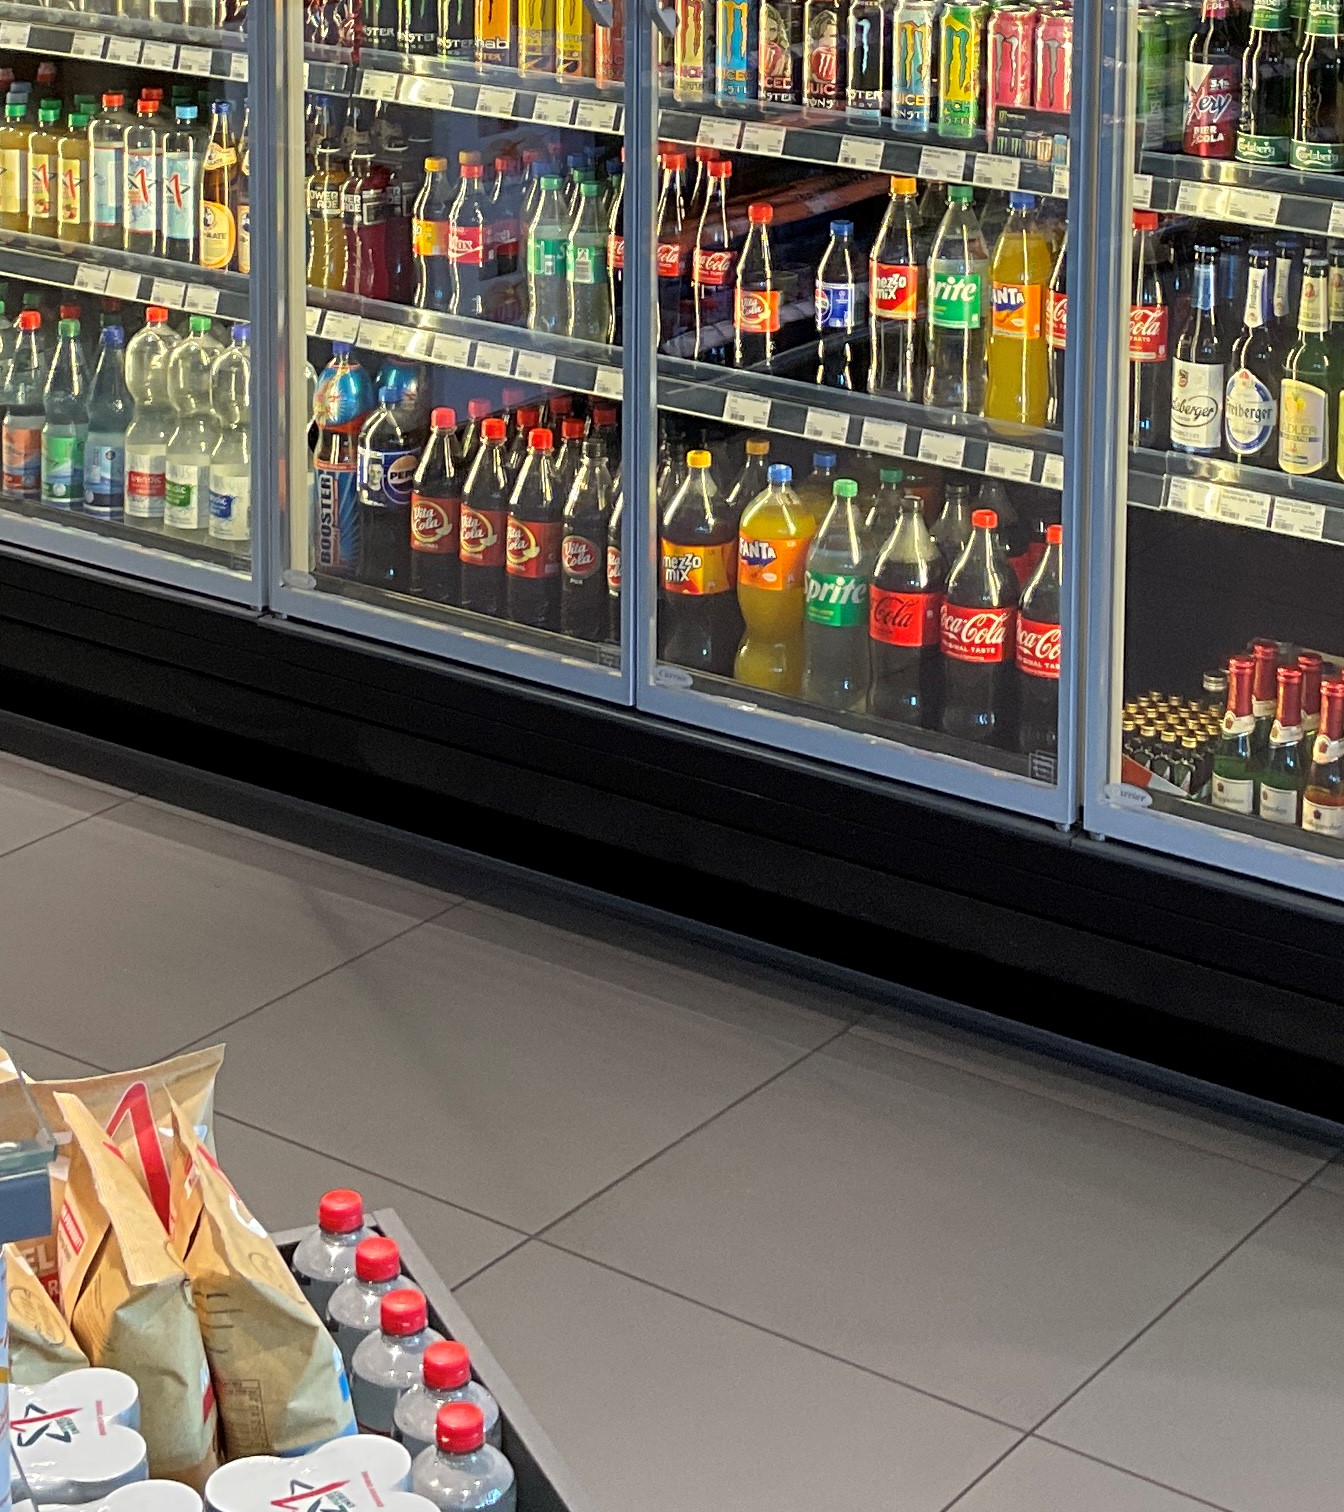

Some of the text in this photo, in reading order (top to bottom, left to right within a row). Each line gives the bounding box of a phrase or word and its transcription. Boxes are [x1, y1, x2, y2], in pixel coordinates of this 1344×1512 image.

[319, 474, 332, 565] BOOSTER
[413, 505, 435, 521] Vita
[414, 518, 440, 533] Cola
[564, 540, 588, 555] Vita
[738, 540, 776, 560] FANTA
[563, 552, 592, 567] Cola
[663, 553, 702, 571] mezzo
[665, 567, 691, 583] mix
[806, 567, 867, 608] Sprite
